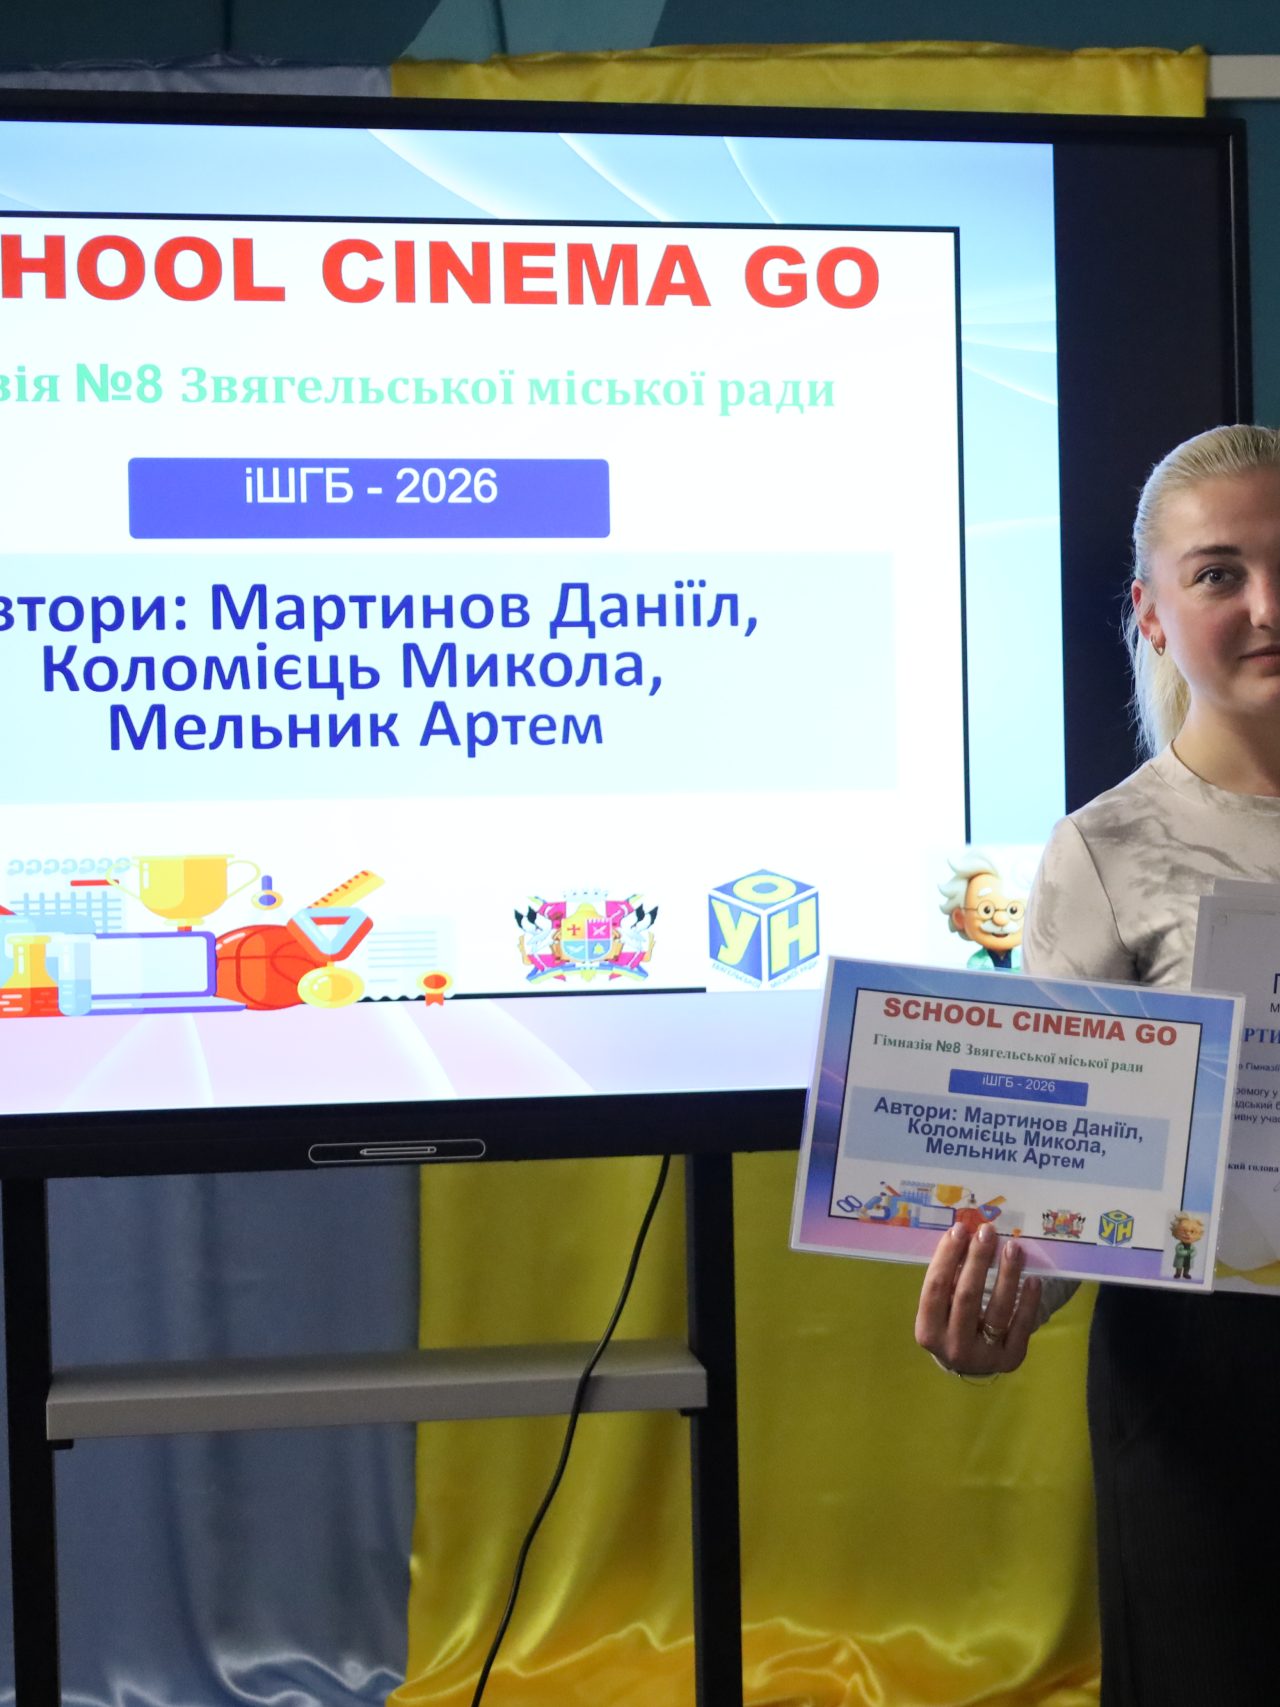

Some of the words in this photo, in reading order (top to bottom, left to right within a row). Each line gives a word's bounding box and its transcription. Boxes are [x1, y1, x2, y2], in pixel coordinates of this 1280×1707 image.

[321, 238, 712, 308] CINEMA
[743, 245, 881, 309] GO
[76, 362, 162, 405] №8
[180, 365, 515, 412] Звягельської
[527, 370, 706, 409] міської
[717, 374, 836, 417] ради
[244, 466, 354, 504] іШГБ
[394, 466, 498, 505] 2026
[211, 583, 529, 642] Мартинов
[550, 581, 760, 638] Даніїл,
[43, 643, 380, 700] Коломієць
[402, 642, 664, 697] Микола,
[109, 704, 400, 752] Мельник
[418, 702, 604, 759] Артем
[883, 997, 1003, 1029] SCHOOL
[1012, 1011, 1126, 1043] CINEMA
[1135, 1018, 1177, 1046] GO
[873, 1033, 932, 1053] Гімназія
[936, 1039, 961, 1054] №8
[965, 1042, 1055, 1065] Звягельської
[1057, 1051, 1108, 1071] міської
[1111, 1059, 1144, 1075] ради
[982, 1074, 1013, 1088] іШГБ
[1025, 1077, 1056, 1093] 2026
[1272, 1091, 1278, 1099] у
[874, 1097, 958, 1126] Автори:
[964, 1106, 1068, 1135] Мартинов
[1073, 1115, 1143, 1143] Даніїл,
[908, 1119, 1017, 1147] Коломієць
[1023, 1131, 1106, 1158] Микола,
[925, 1136, 1018, 1162] Мельник
[1023, 1148, 1085, 1171] Артем
[1248, 1165, 1279, 1173] голова
